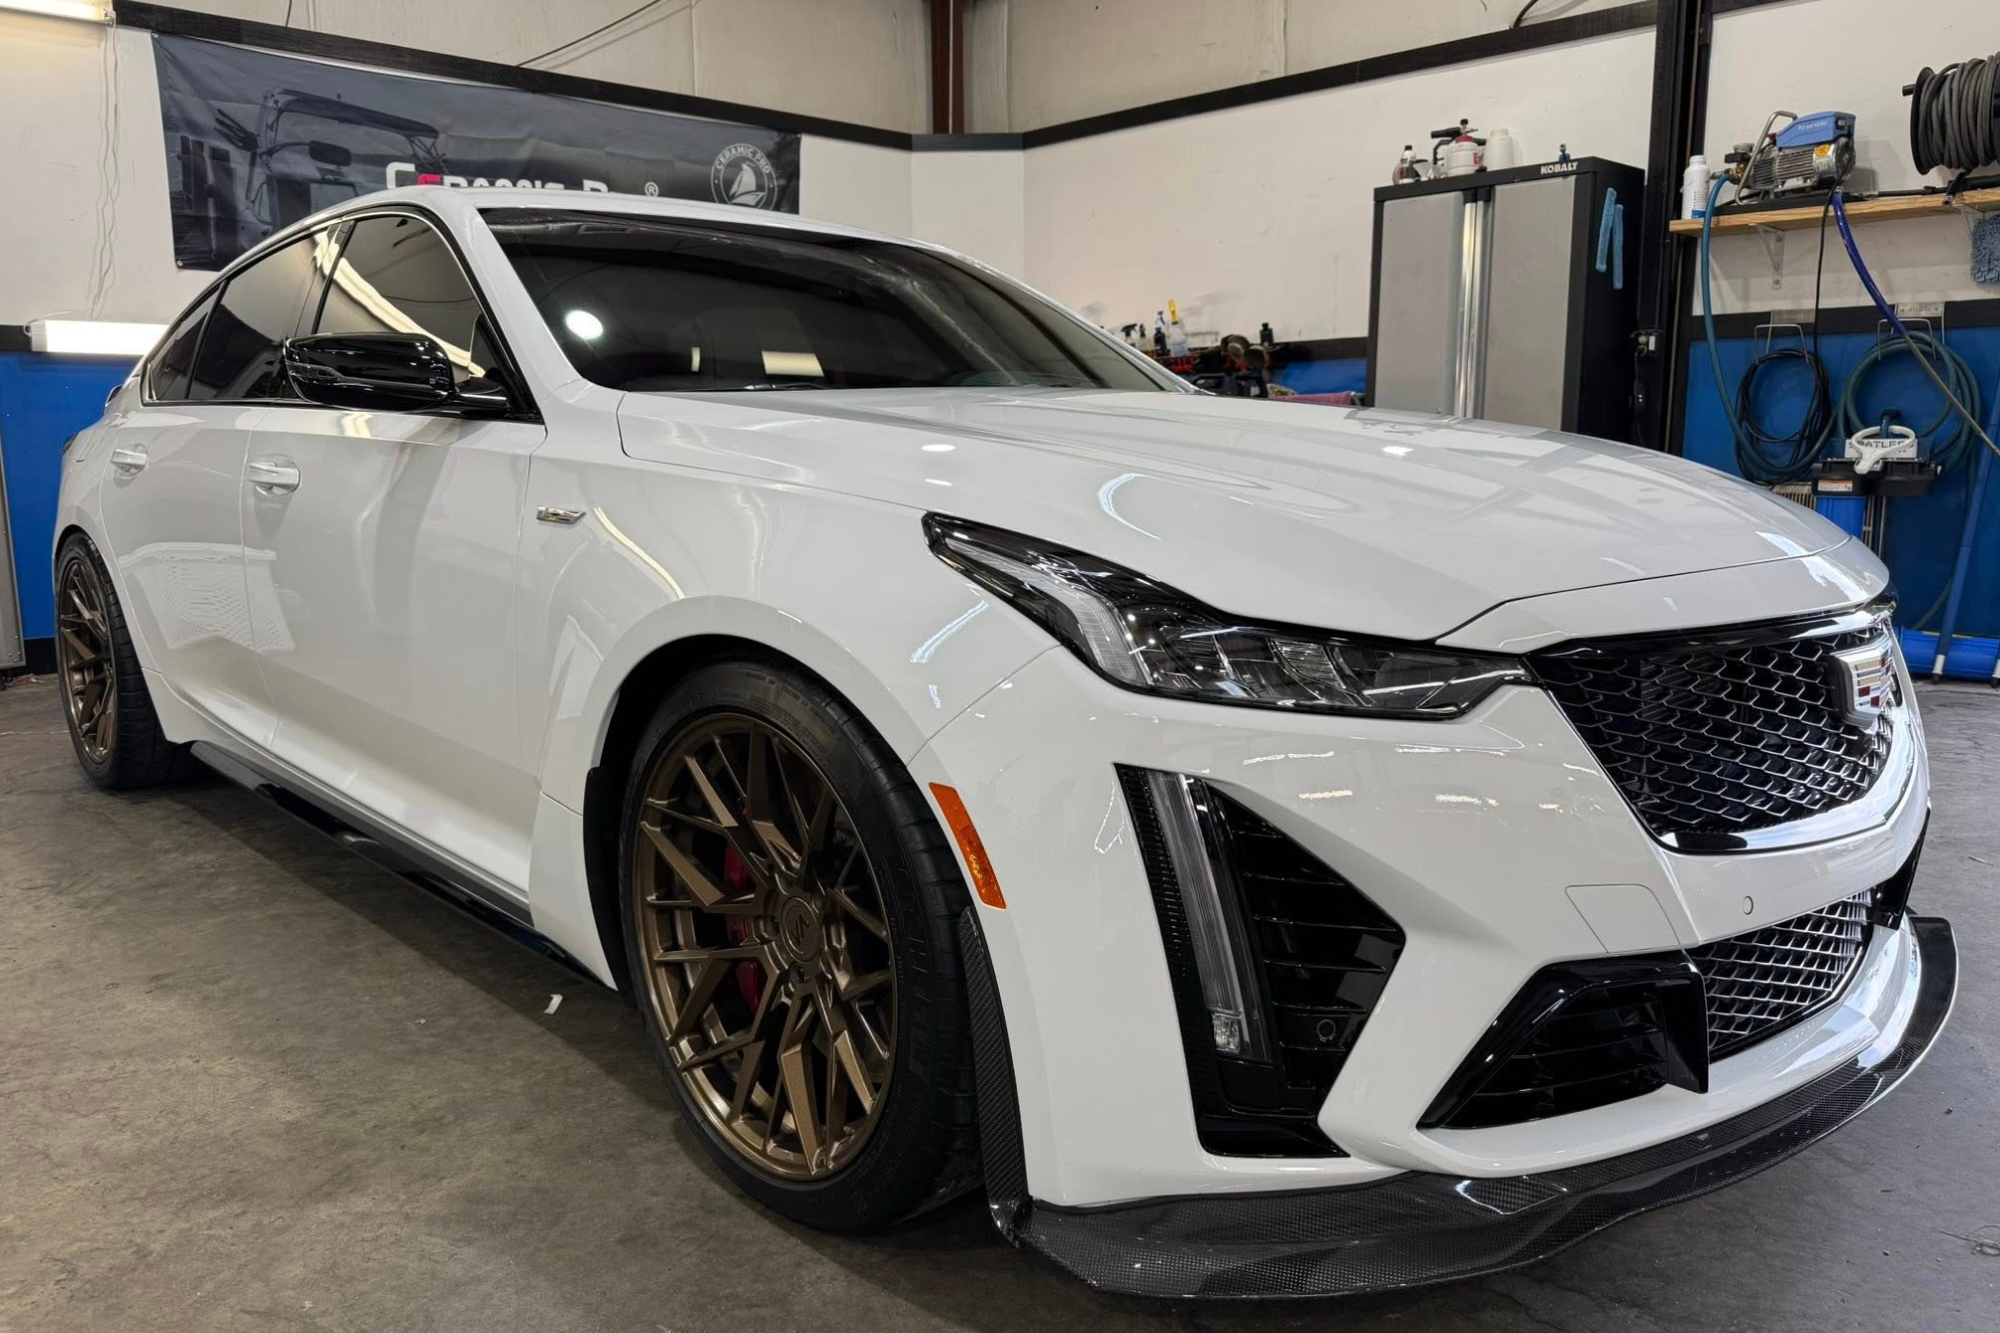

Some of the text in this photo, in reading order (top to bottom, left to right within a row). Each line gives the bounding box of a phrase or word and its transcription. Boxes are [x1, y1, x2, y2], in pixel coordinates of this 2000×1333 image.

[715, 146, 771, 174] CERAMIC PRO
[1540, 161, 1579, 175] KOBALT
